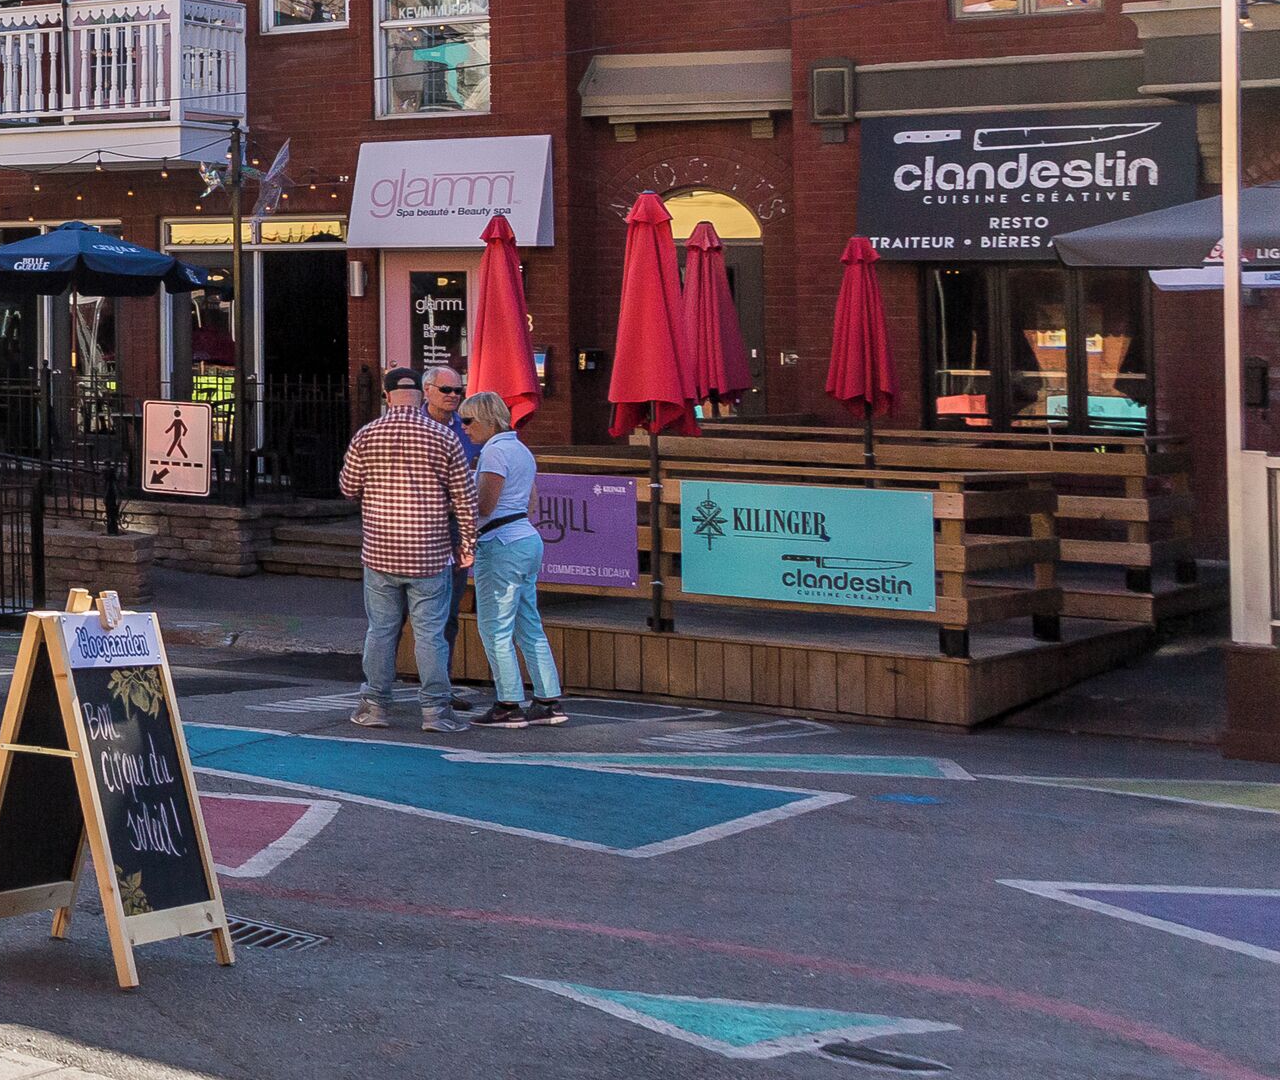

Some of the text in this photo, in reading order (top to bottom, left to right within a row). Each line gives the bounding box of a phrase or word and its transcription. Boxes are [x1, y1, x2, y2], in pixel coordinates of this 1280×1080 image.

[894, 151, 1159, 191] clandestin
[923, 190, 1132, 205] CUISINE CRÉATIVE
[396, 207, 511, 218] Spa beauté Beauty spa
[989, 217, 1049, 229] RESTO
[869, 236, 955, 249] TRAITEUR
[981, 232, 1041, 248] BIÈRES
[538, 496, 595, 543] HULL
[732, 507, 828, 537] KILINGER
[547, 563, 597, 577] COMMERCES
[598, 566, 631, 578] LOCAUX
[782, 569, 912, 596] clandestin
[76, 626, 150, 663] Hoegaarden
